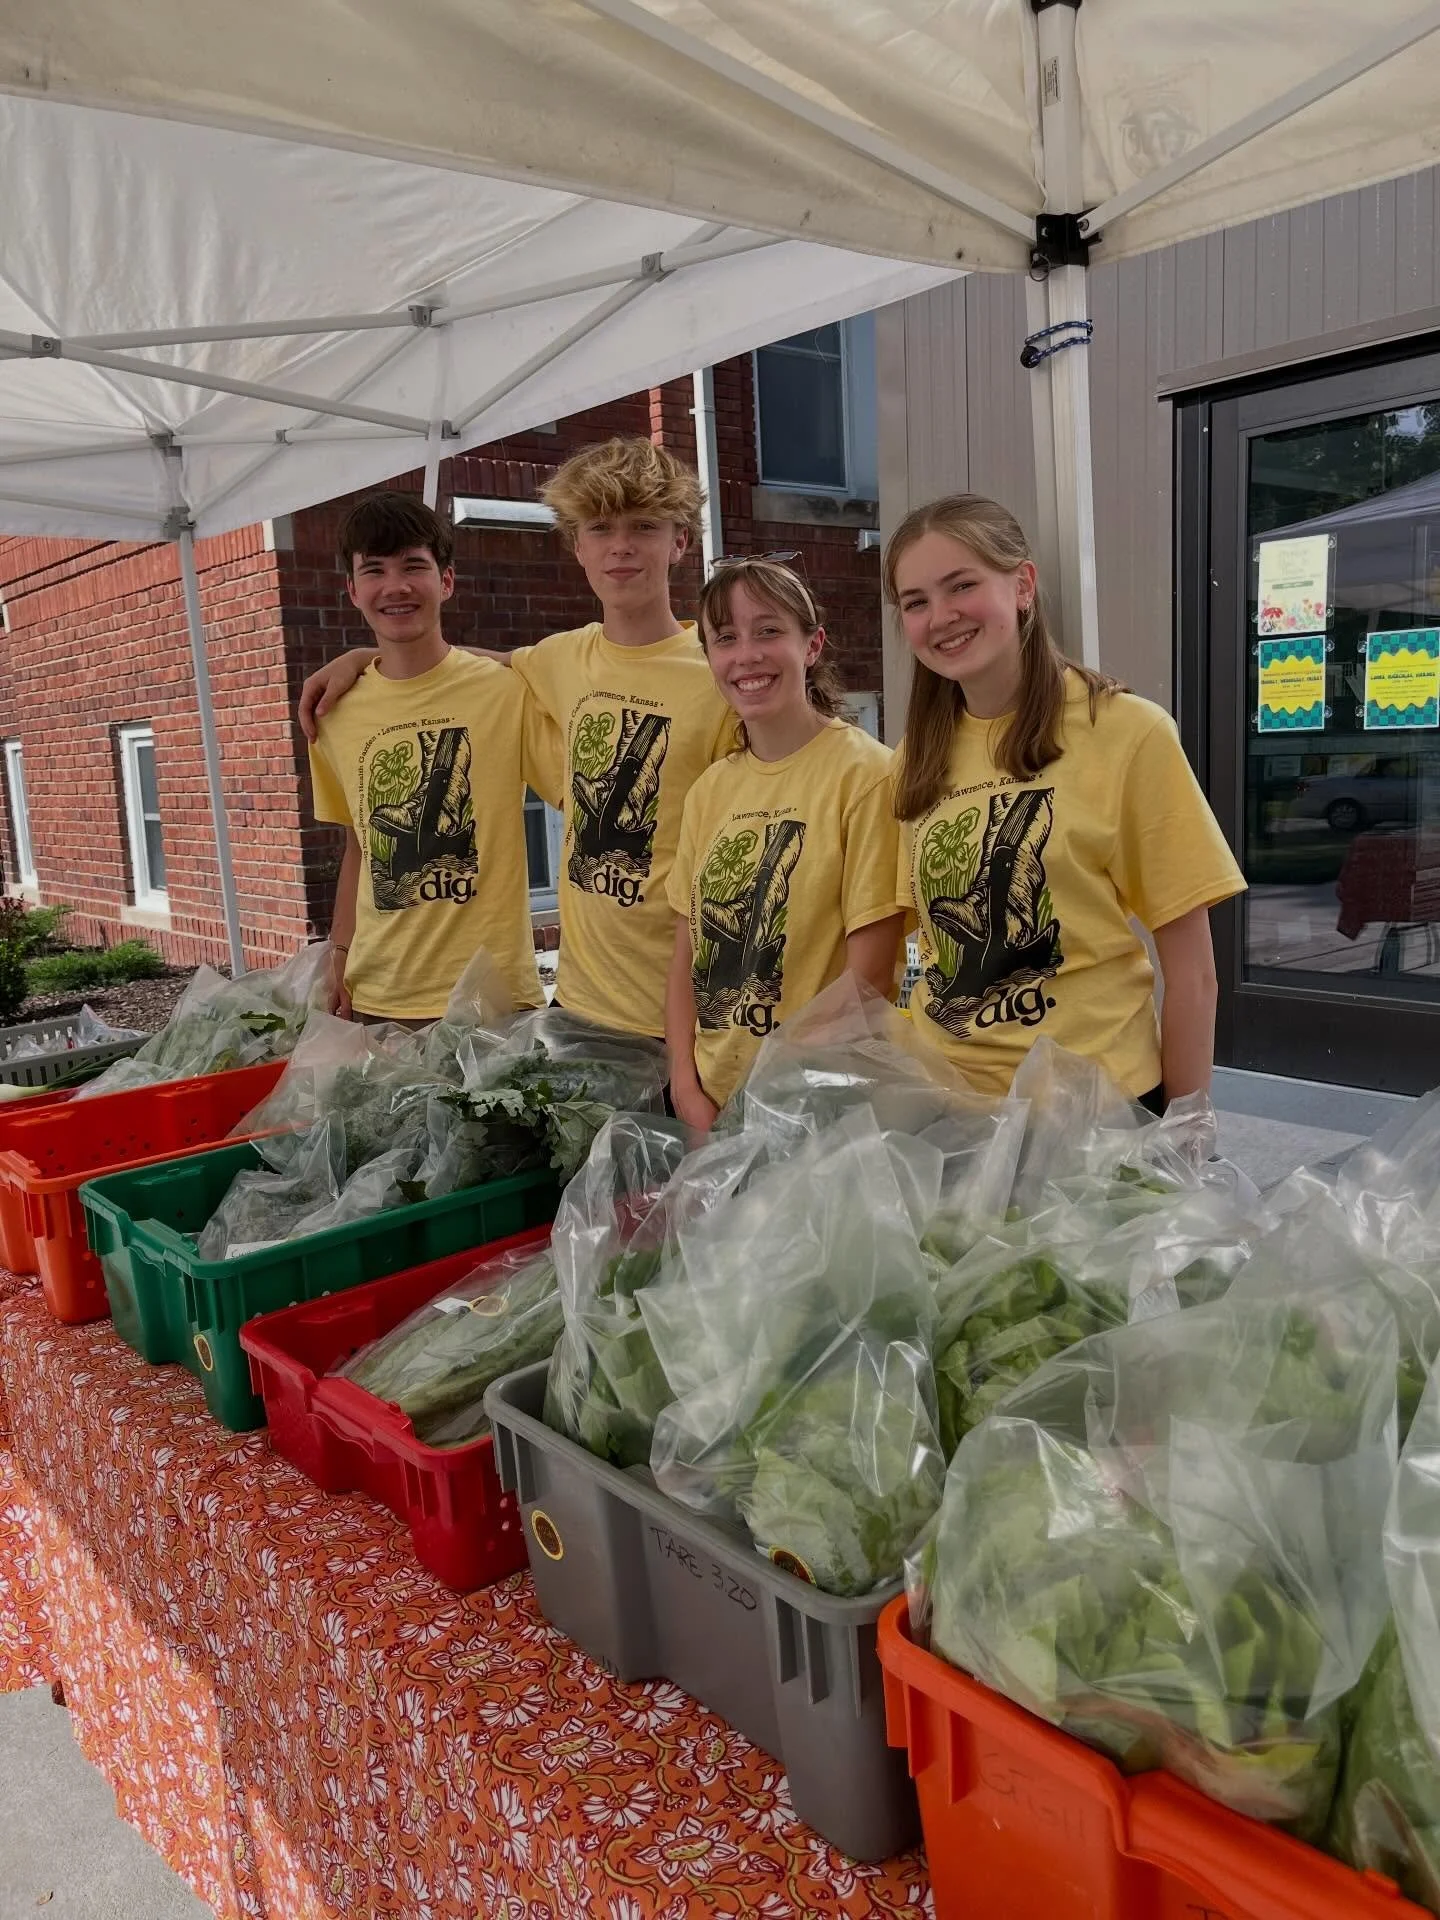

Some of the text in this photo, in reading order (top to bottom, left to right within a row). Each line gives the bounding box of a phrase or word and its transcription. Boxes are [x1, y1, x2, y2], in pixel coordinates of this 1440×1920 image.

[629, 695, 659, 708] Kansas
[381, 720, 420, 736] Lawrence,
[421, 717, 450, 727] Kansas
[419, 869, 478, 905] dig.
[594, 864, 645, 908] dig.
[975, 980, 1057, 1028] dig.
